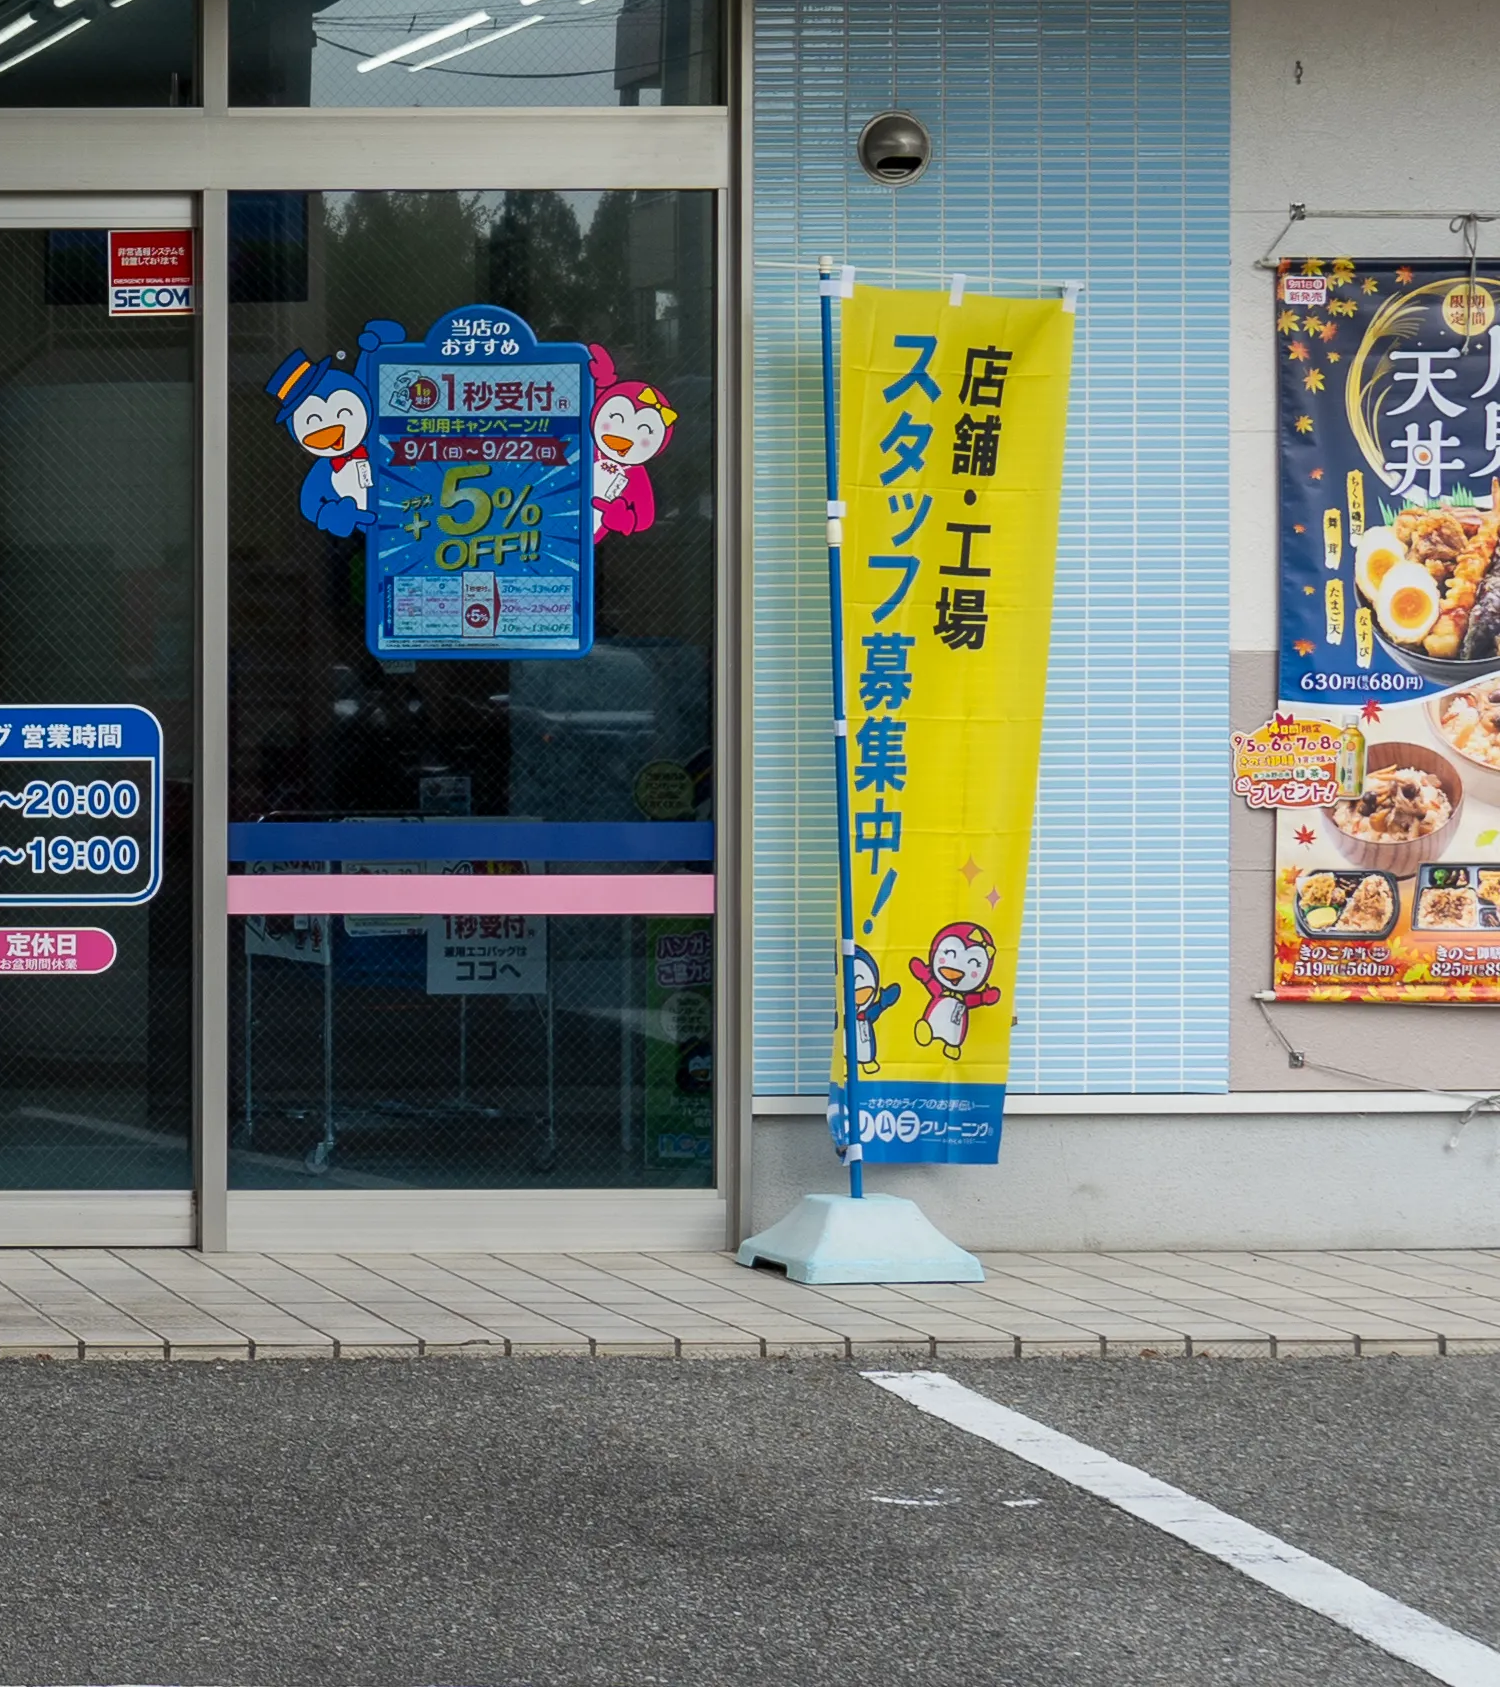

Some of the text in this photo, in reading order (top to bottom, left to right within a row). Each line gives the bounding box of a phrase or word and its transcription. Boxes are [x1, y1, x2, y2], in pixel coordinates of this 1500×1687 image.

[114, 288, 190, 308] SECOM
[1288, 291, 1323, 303] 新発売
[451, 318, 511, 337] 当店の
[441, 338, 520, 356] おすすめ
[441, 373, 556, 412] 1秒受付
[932, 345, 1014, 652] 店舗・工場
[434, 530, 540, 571] OFF!!
[1328, 587, 1341, 635] たまご天
[1358, 615, 1370, 658] なすび
[21, 723, 123, 749] 営業時間
[5, 932, 79, 958] 定休日
[1299, 945, 1367, 961] きのこ弁当
[456, 961, 522, 981] ココへ
